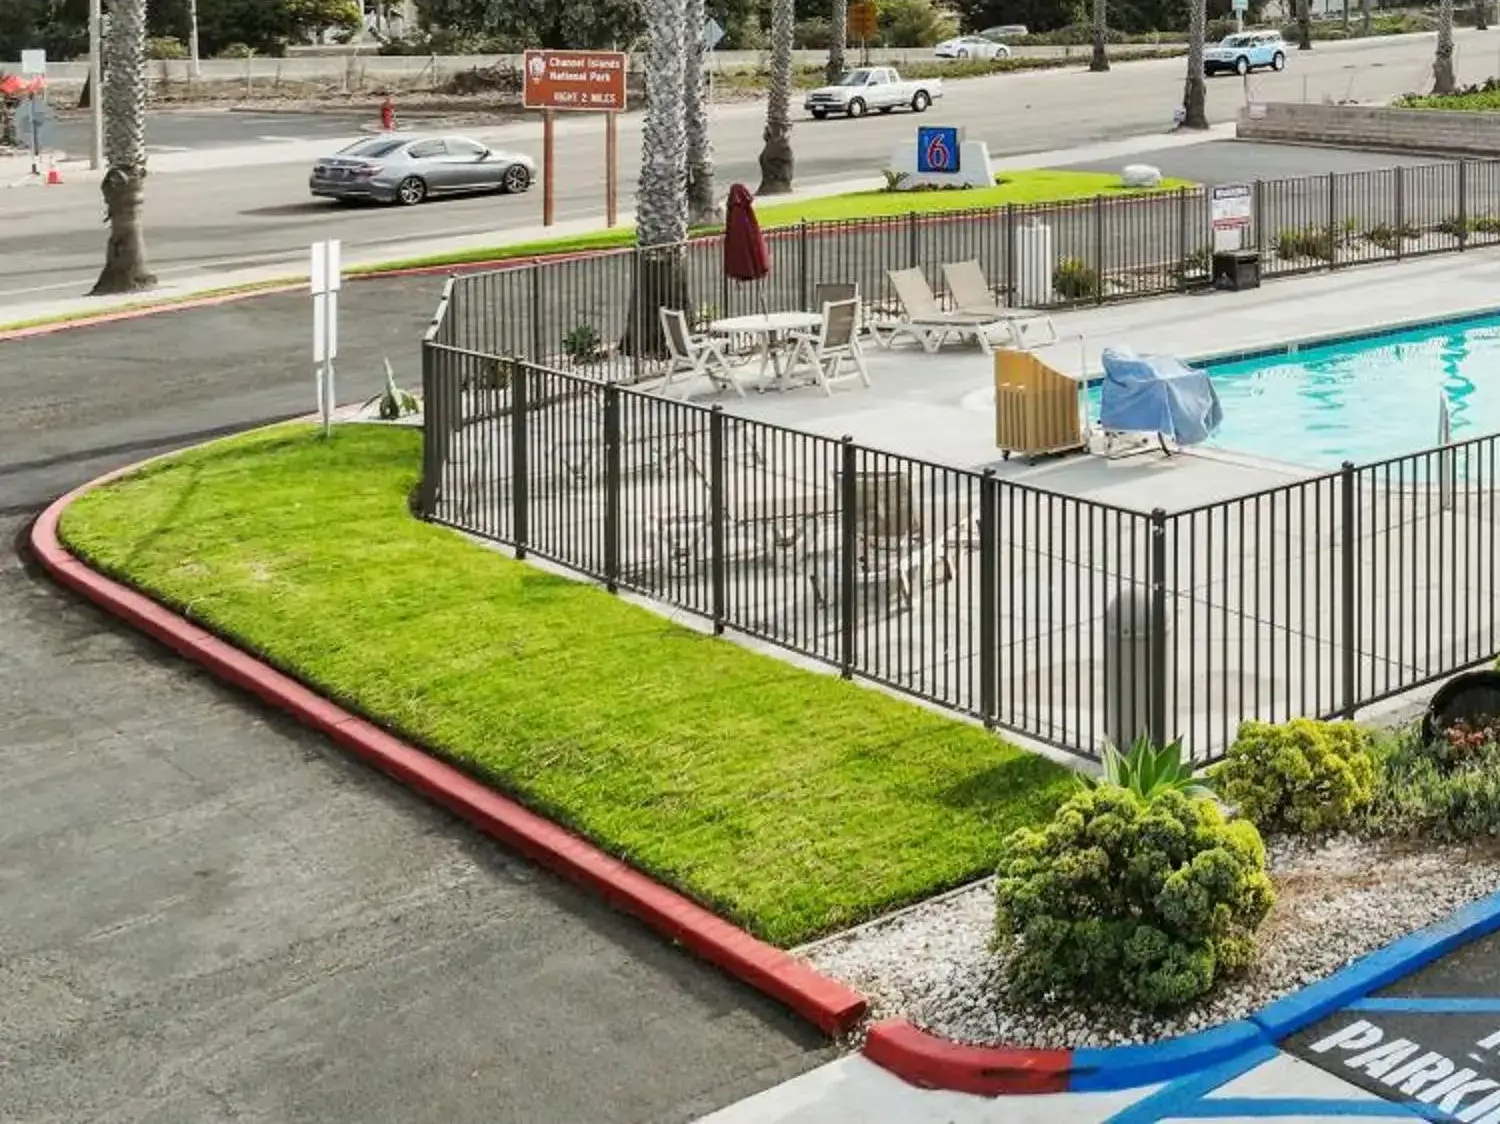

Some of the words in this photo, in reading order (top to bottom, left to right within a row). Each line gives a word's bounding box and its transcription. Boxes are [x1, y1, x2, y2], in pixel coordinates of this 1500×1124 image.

[550, 58, 585, 68] Channel
[588, 58, 620, 69] Islands
[550, 72, 587, 81] National
[590, 72, 611, 82] Park
[554, 92, 577, 102] RIGHT
[591, 93, 616, 104] MILES
[927, 133, 949, 170] 6
